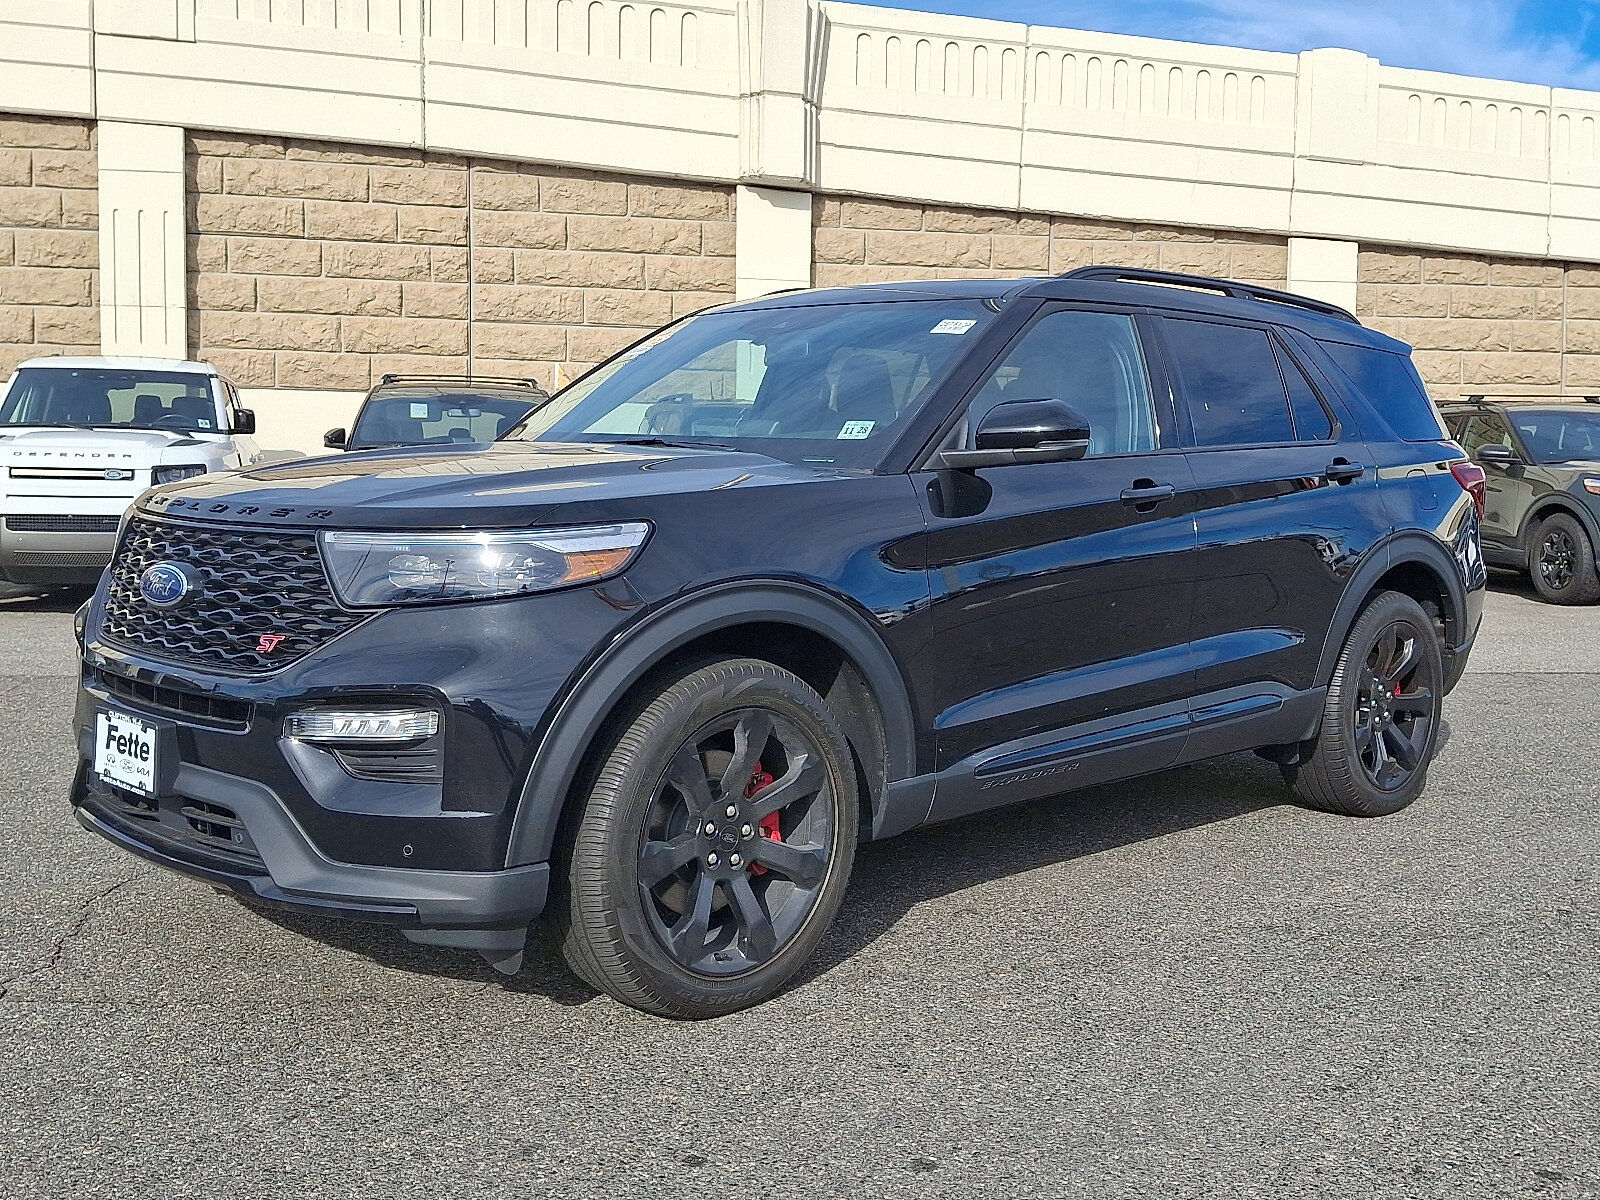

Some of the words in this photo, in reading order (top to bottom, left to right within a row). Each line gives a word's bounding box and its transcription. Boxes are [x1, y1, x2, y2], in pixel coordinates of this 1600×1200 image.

[147, 571, 175, 597] Ford
[256, 634, 285, 652] ST
[105, 724, 149, 762] Fette
[980, 762, 1080, 790] EXPLORER
